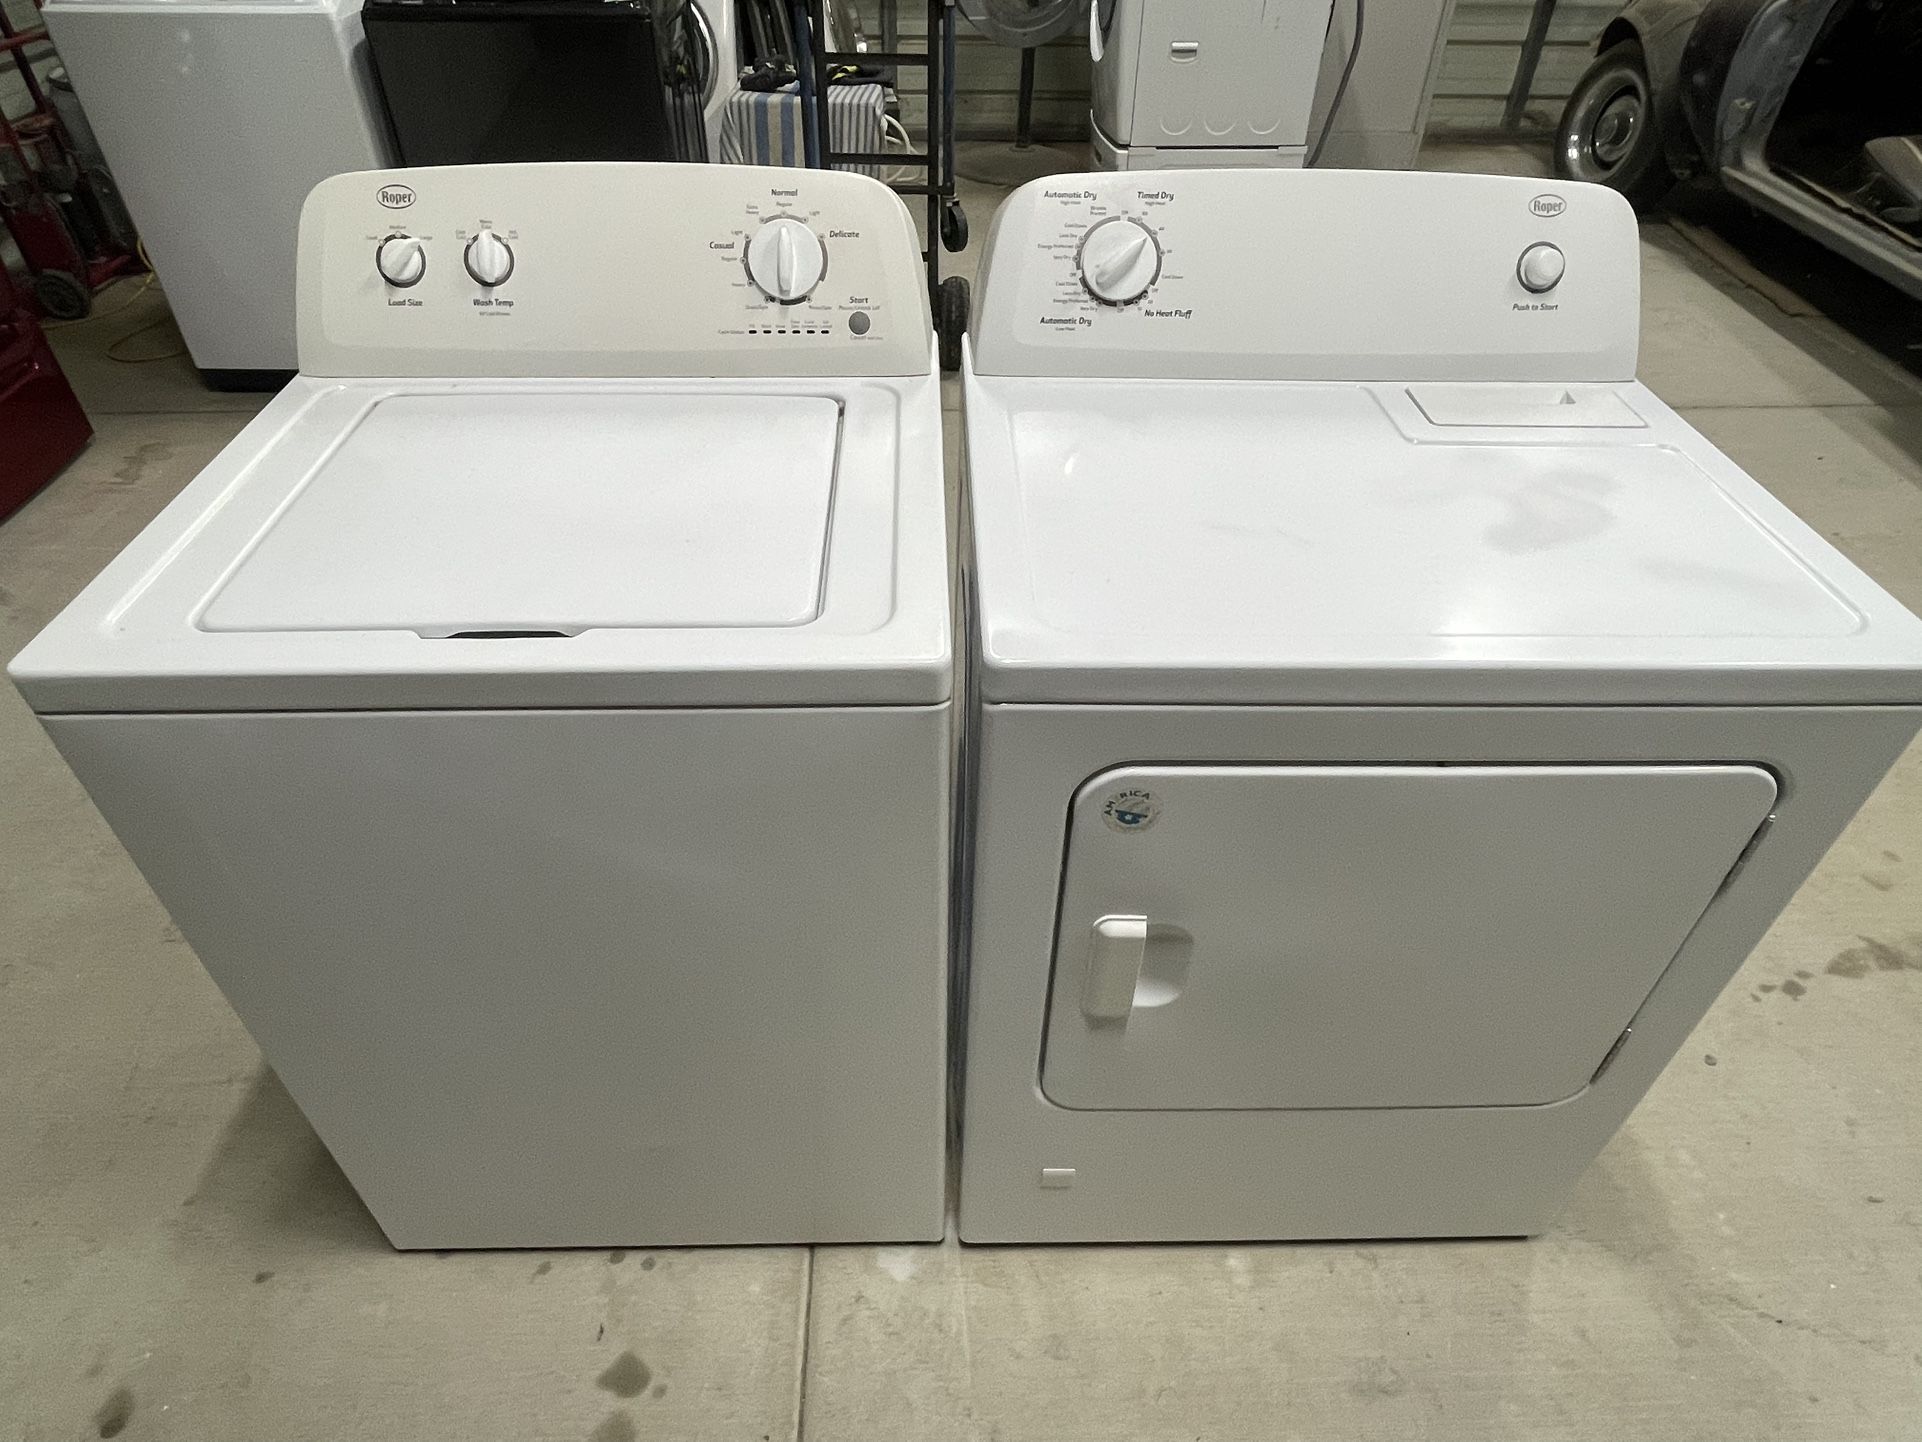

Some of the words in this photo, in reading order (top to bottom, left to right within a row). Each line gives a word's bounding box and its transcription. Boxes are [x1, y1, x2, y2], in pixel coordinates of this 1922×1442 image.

[771, 188, 798, 197] Normal
[1044, 190, 1083, 199] Automatic
[1084, 190, 1098, 201] Dry
[1137, 191, 1160, 200] Timed
[1161, 191, 1175, 202] Dry
[381, 191, 413, 205] Roper
[1533, 200, 1563, 214] Roper
[829, 230, 860, 239] Delicate
[709, 241, 735, 250] Casual
[388, 298, 406, 307] Load
[407, 298, 423, 307] Size
[473, 298, 493, 307] Wash
[495, 298, 514, 308] Temp
[849, 296, 869, 304] Start
[1512, 303, 1530, 311] Push
[1531, 303, 1539, 311] to
[1539, 303, 1559, 311] Start
[1144, 310, 1155, 318] No
[1155, 309, 1173, 318] Heat
[1174, 309, 1193, 319] Fluff
[1040, 317, 1077, 325] Automatic
[1078, 316, 1092, 327] Dry
[1104, 790, 1150, 816] AMRICA
